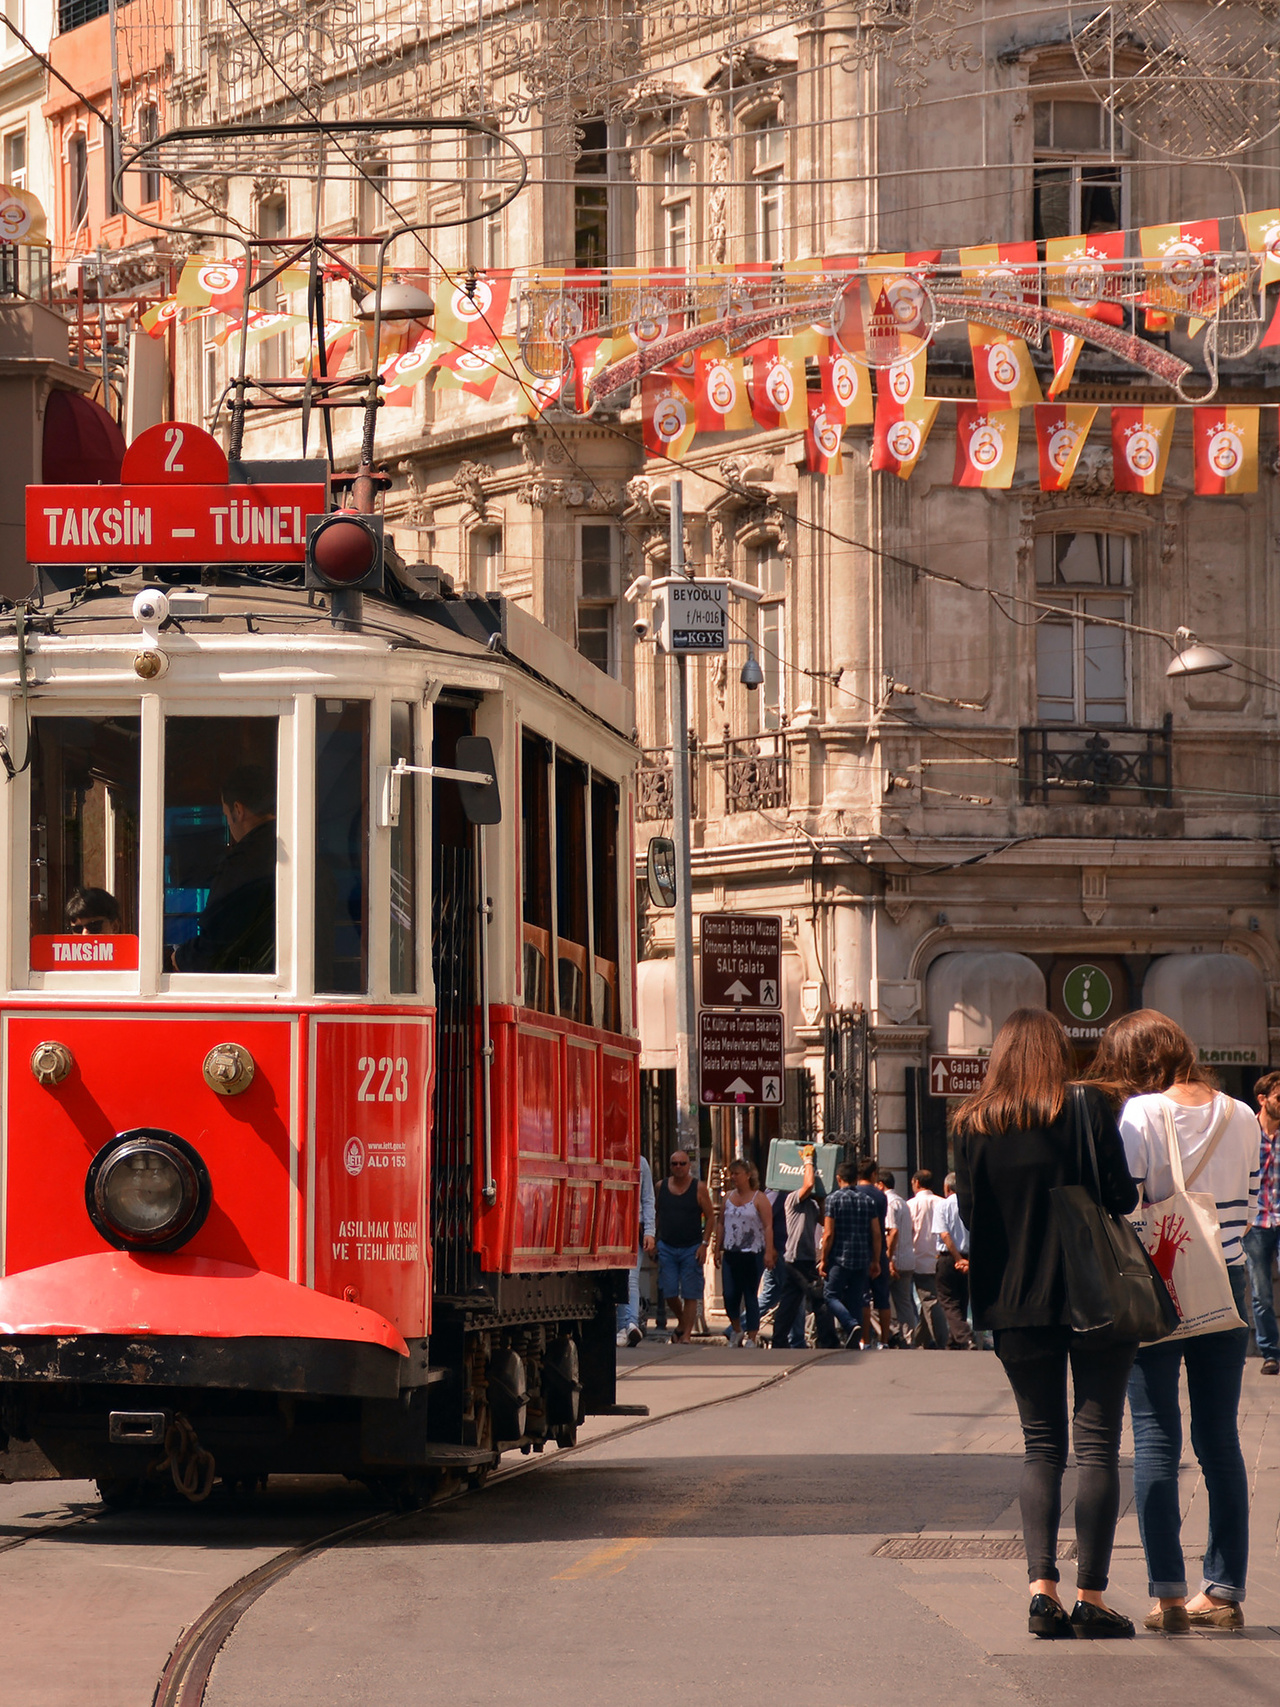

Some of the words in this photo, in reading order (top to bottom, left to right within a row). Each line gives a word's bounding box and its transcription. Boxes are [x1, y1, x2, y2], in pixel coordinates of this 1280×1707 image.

[164, 428, 184, 472] 2
[43, 500, 152, 545] TAKSİM
[209, 500, 307, 545] TÜNEL
[673, 586, 721, 601] BEYOĞLU
[688, 632, 723, 643] KGYS
[705, 920, 730, 934] Osmanlı
[731, 920, 755, 935] Bankası
[756, 921, 778, 936] Müzesi
[705, 939, 731, 954] Ottoman
[733, 940, 749, 954] Bank
[750, 940, 778, 955] Museum
[717, 958, 737, 973] SALT
[738, 958, 765, 974] Galata
[703, 1037, 721, 1051] Galata
[704, 1056, 720, 1070] Galata
[950, 1060, 979, 1074] Galata
[358, 1056, 408, 1102] 223
[367, 1155, 389, 1167] ALO
[391, 1155, 406, 1167] 153
[339, 1221, 389, 1239] ASILMAK
[393, 1221, 417, 1239] YASAK
[332, 1243, 349, 1260] VE
[356, 1241, 419, 1261] TEHLİKELİDİR
